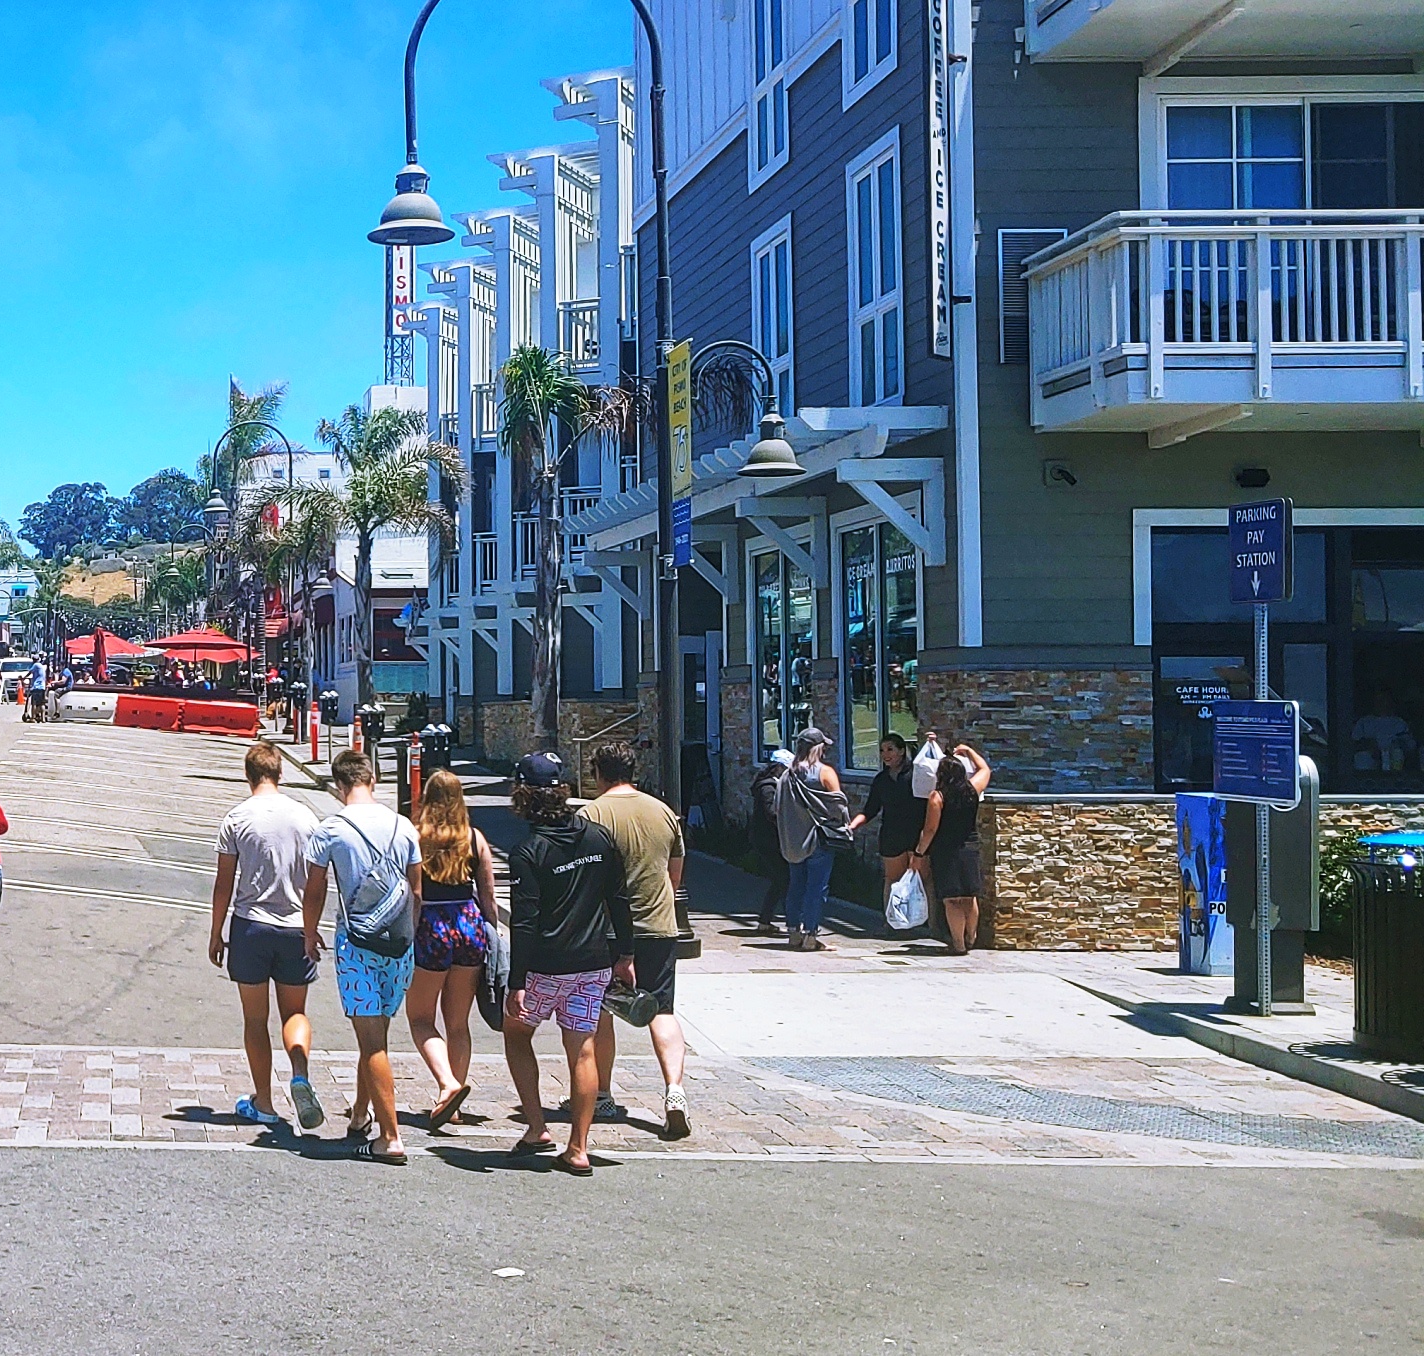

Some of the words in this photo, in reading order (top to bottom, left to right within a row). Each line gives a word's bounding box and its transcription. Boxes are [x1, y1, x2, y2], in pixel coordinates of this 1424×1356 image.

[936, 148, 944, 209] ICE
[936, 221, 946, 324] CREAM
[1236, 506, 1276, 523] PARKING
[1247, 530, 1264, 544] PAY
[1237, 551, 1275, 567] STATION
[1175, 686, 1199, 694] CAFE
